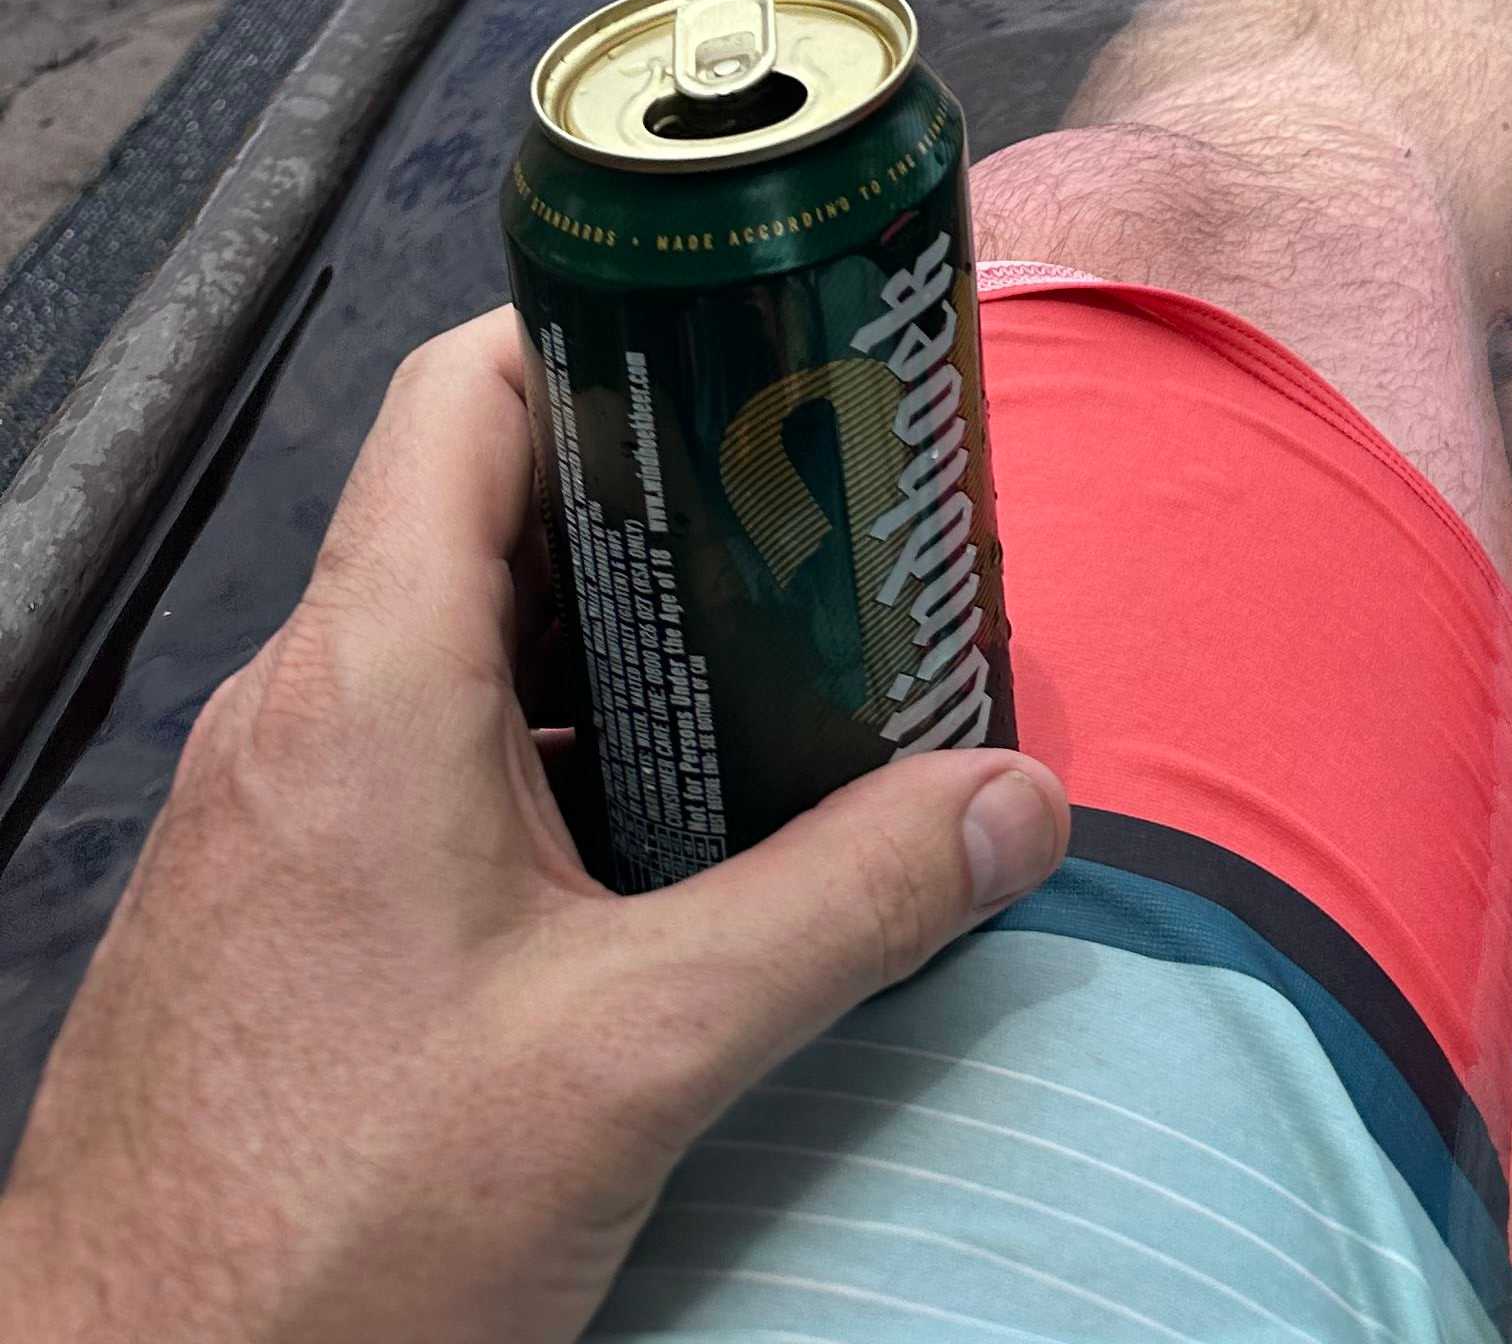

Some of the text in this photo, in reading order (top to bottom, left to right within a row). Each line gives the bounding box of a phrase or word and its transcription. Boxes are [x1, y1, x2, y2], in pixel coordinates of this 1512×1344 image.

[656, 232, 714, 252] MADE
[728, 196, 850, 247] ACCORDING
[858, 179, 881, 201] TO
[888, 154, 916, 183] THE
[626, 351, 670, 533] www.windhoekbeer.com
[606, 529, 625, 559] HOPS
[620, 623, 639, 665] BARLEY
[624, 519, 683, 829] CONSUMER CARE LINE: 0800 026 027 (RSA ONLY)
[687, 655, 707, 675] CAN
[690, 676, 709, 690] OF
[626, 666, 646, 708] MALTED
[649, 547, 708, 833] Not for Persons Under the Age of 18
[693, 693, 714, 732] BOTTOM
[698, 733, 717, 750] SEE
[704, 777, 723, 811] BEFORE
